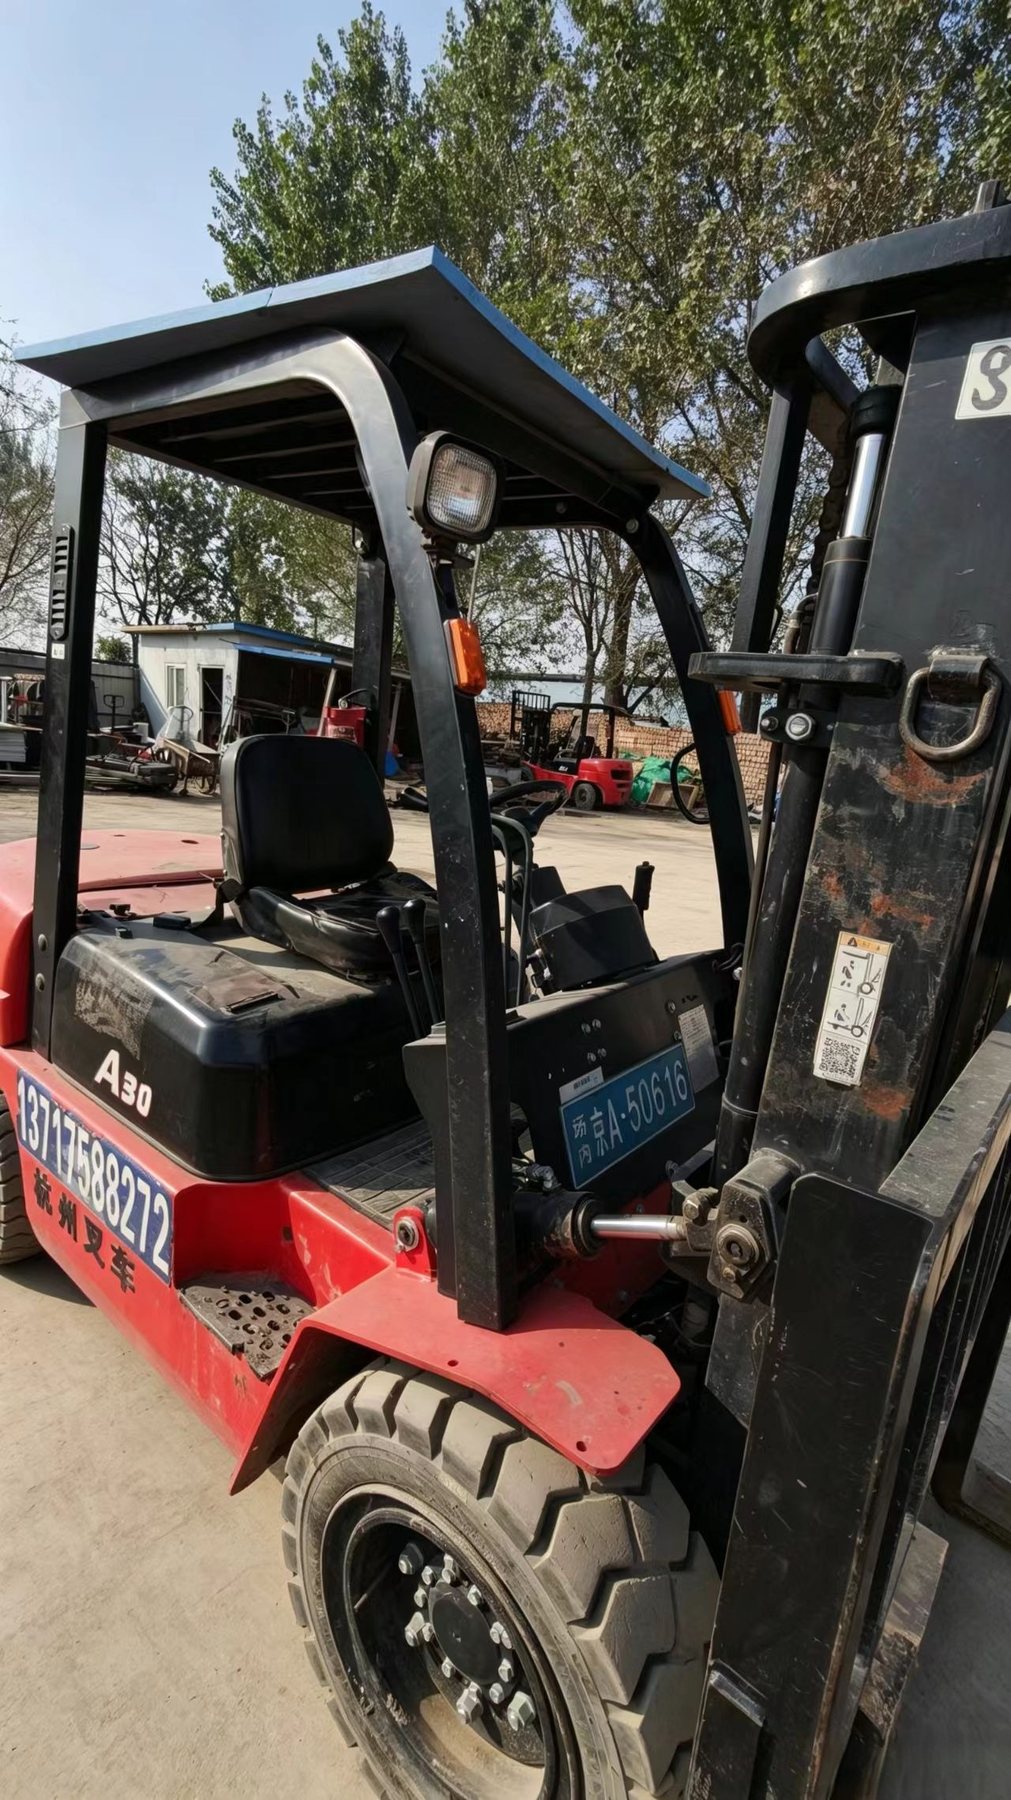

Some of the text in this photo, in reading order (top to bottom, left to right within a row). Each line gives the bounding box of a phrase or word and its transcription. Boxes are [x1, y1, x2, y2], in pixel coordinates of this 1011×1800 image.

[94, 1049, 153, 1117] A30
[17, 1076, 170, 1276] 13717588272
[33, 1168, 136, 1294] 杭州叉车
